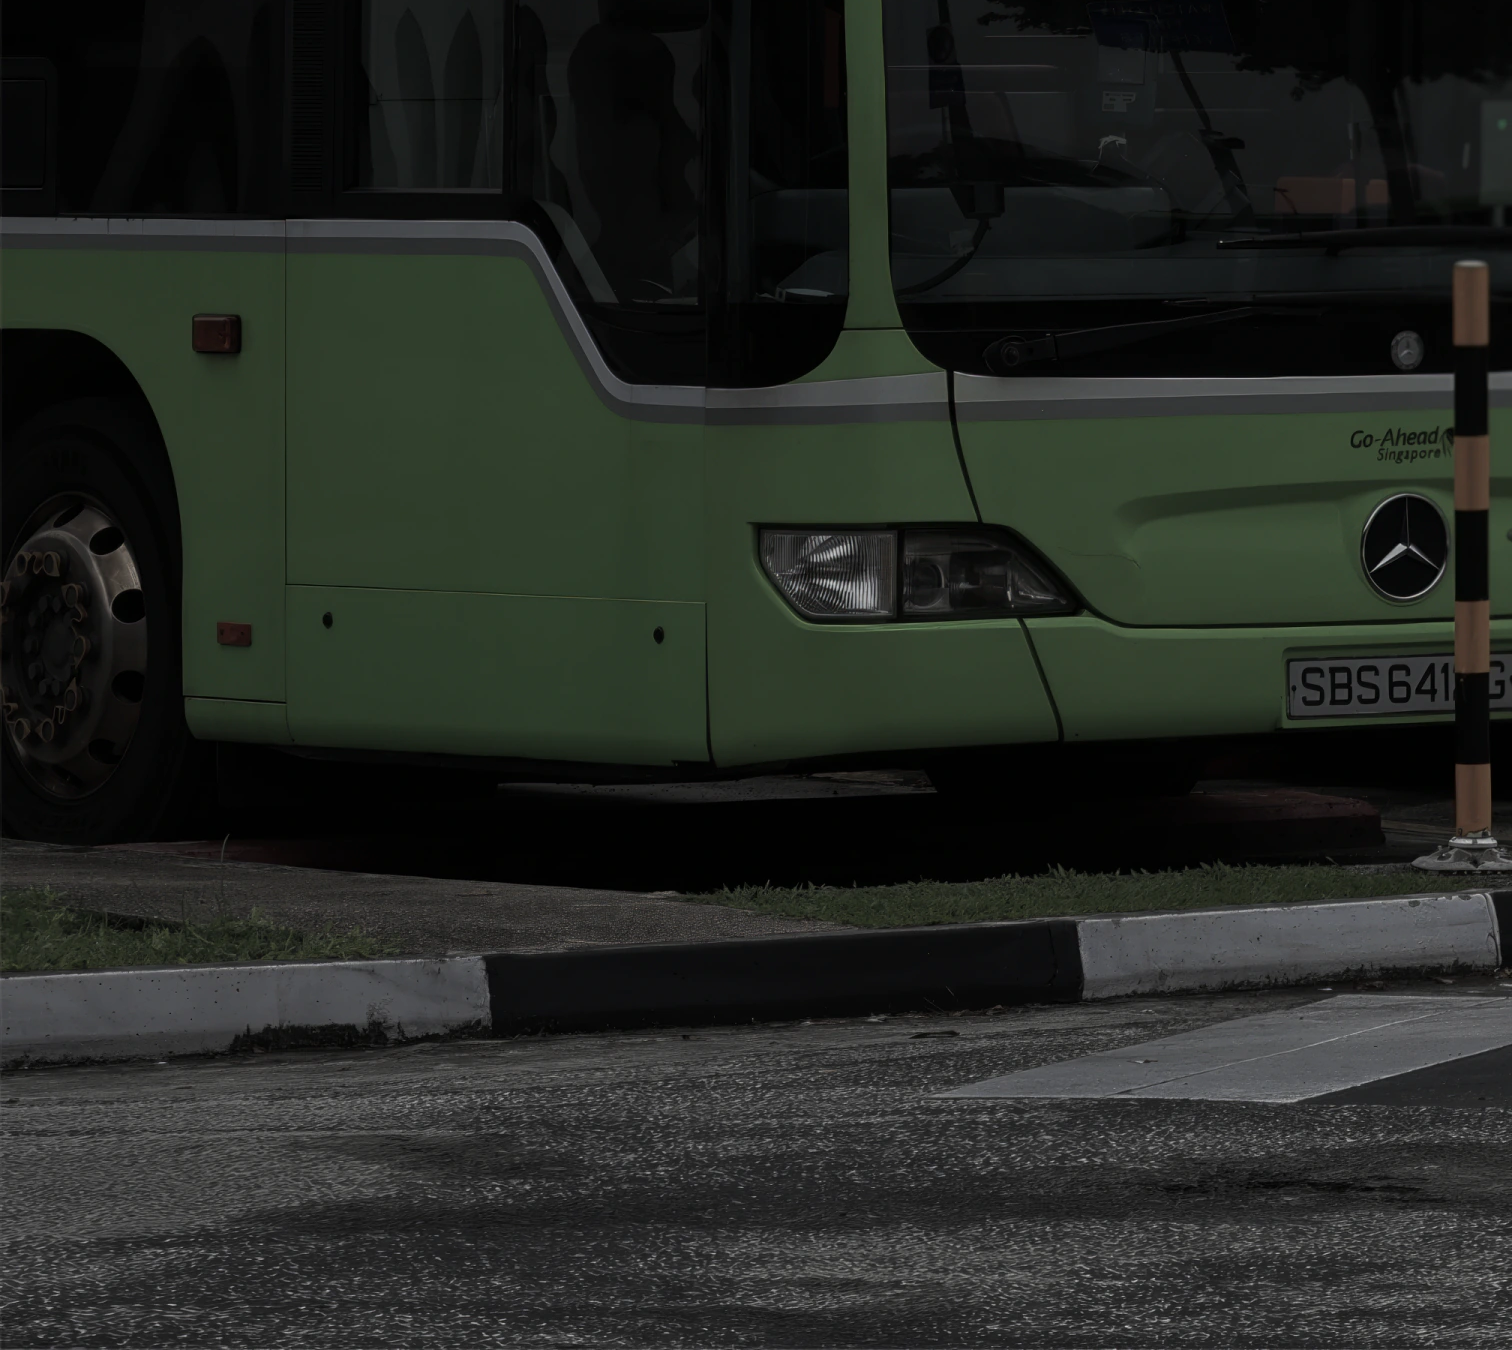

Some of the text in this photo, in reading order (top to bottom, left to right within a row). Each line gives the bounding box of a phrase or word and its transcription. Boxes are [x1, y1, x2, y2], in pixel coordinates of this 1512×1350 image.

[1350, 426, 1440, 449] Go-Ahead
[1376, 447, 1441, 464] Singapore
[1301, 659, 1506, 706] SBS641G
